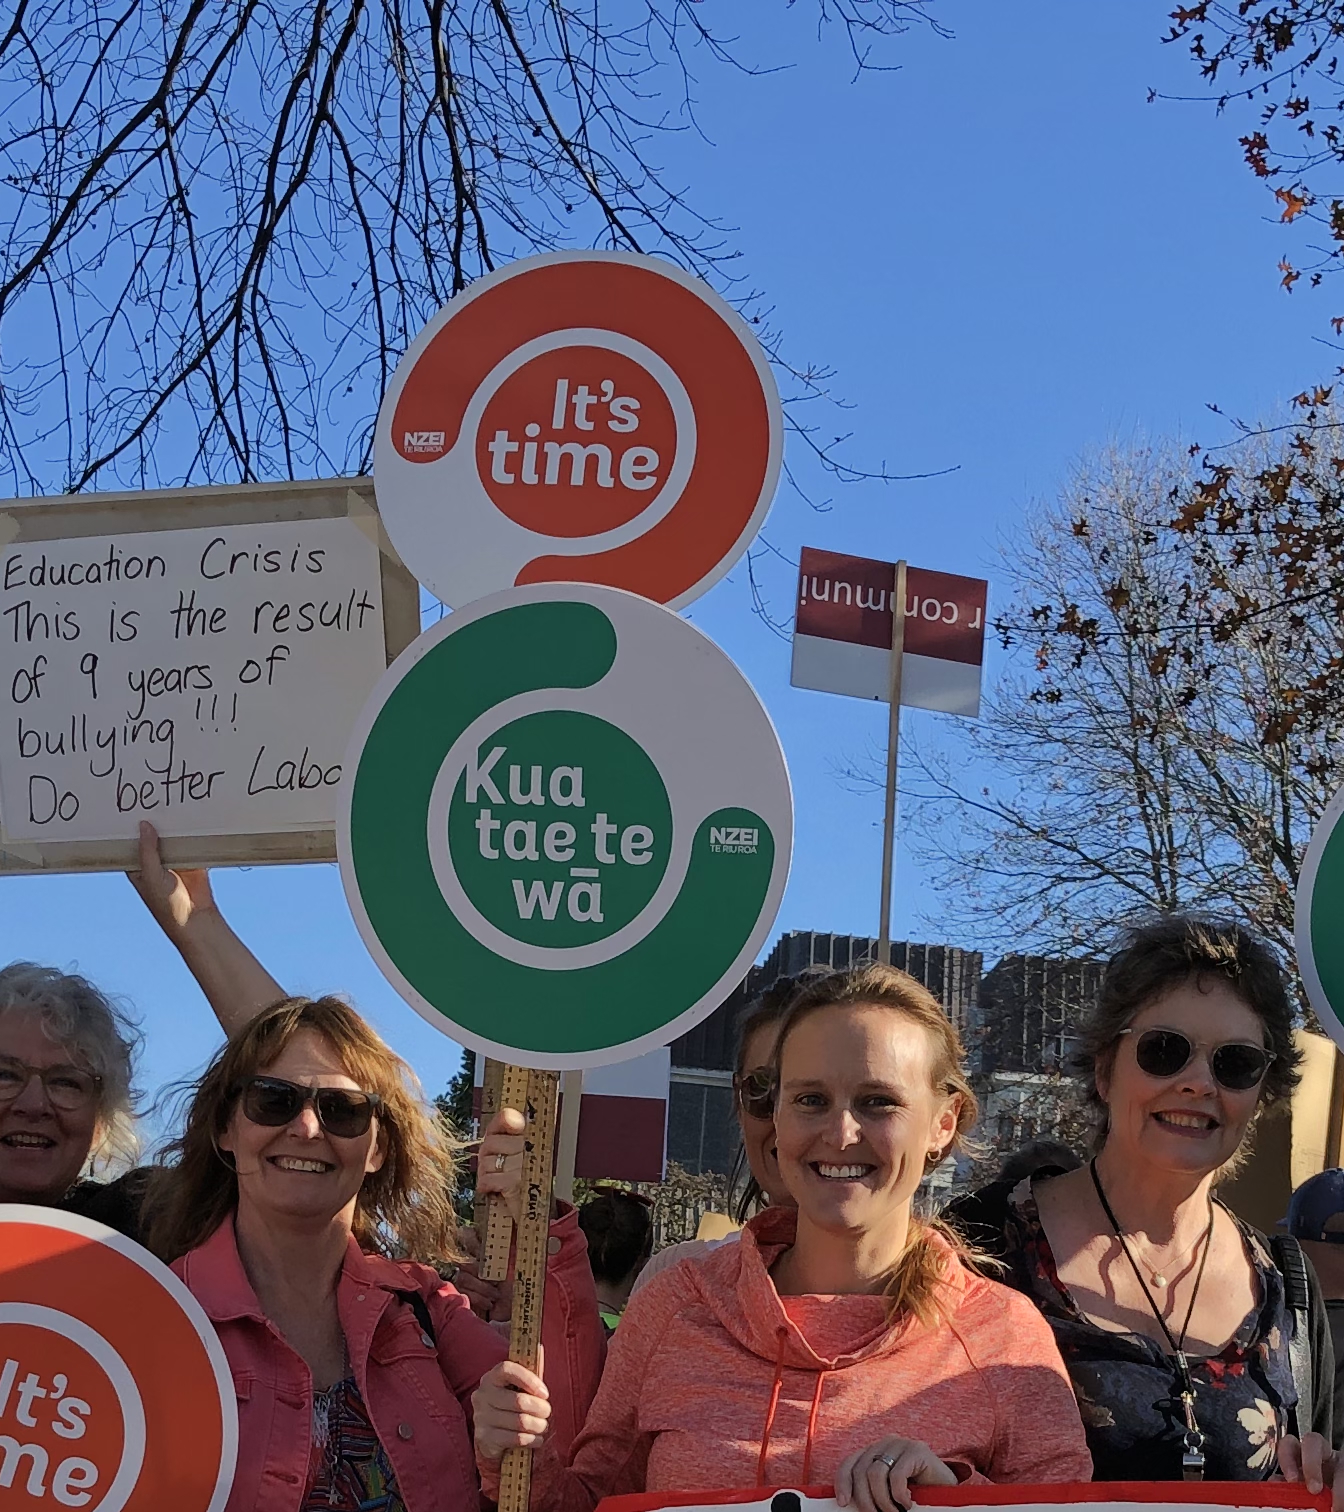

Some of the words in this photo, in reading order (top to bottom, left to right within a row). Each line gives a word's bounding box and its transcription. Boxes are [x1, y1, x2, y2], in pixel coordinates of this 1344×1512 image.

[551, 378, 641, 433] It's
[404, 431, 445, 446] NZEI
[488, 424, 660, 490] time
[4, 544, 166, 591] Education
[200, 538, 325, 580] Crisis
[4, 600, 80, 643] This
[109, 602, 140, 642] is
[170, 591, 227, 639] the
[253, 589, 375, 635] result
[12, 655, 47, 703] of
[80, 653, 99, 698] 9
[127, 663, 213, 720] years
[239, 645, 290, 685] of
[29, 775, 79, 824] Do
[116, 768, 225, 813] better
[464, 746, 585, 808] Kua
[476, 810, 576, 864] tae
[591, 812, 654, 866] te
[710, 827, 758, 845] NZEI
[512, 867, 605, 923] wā
